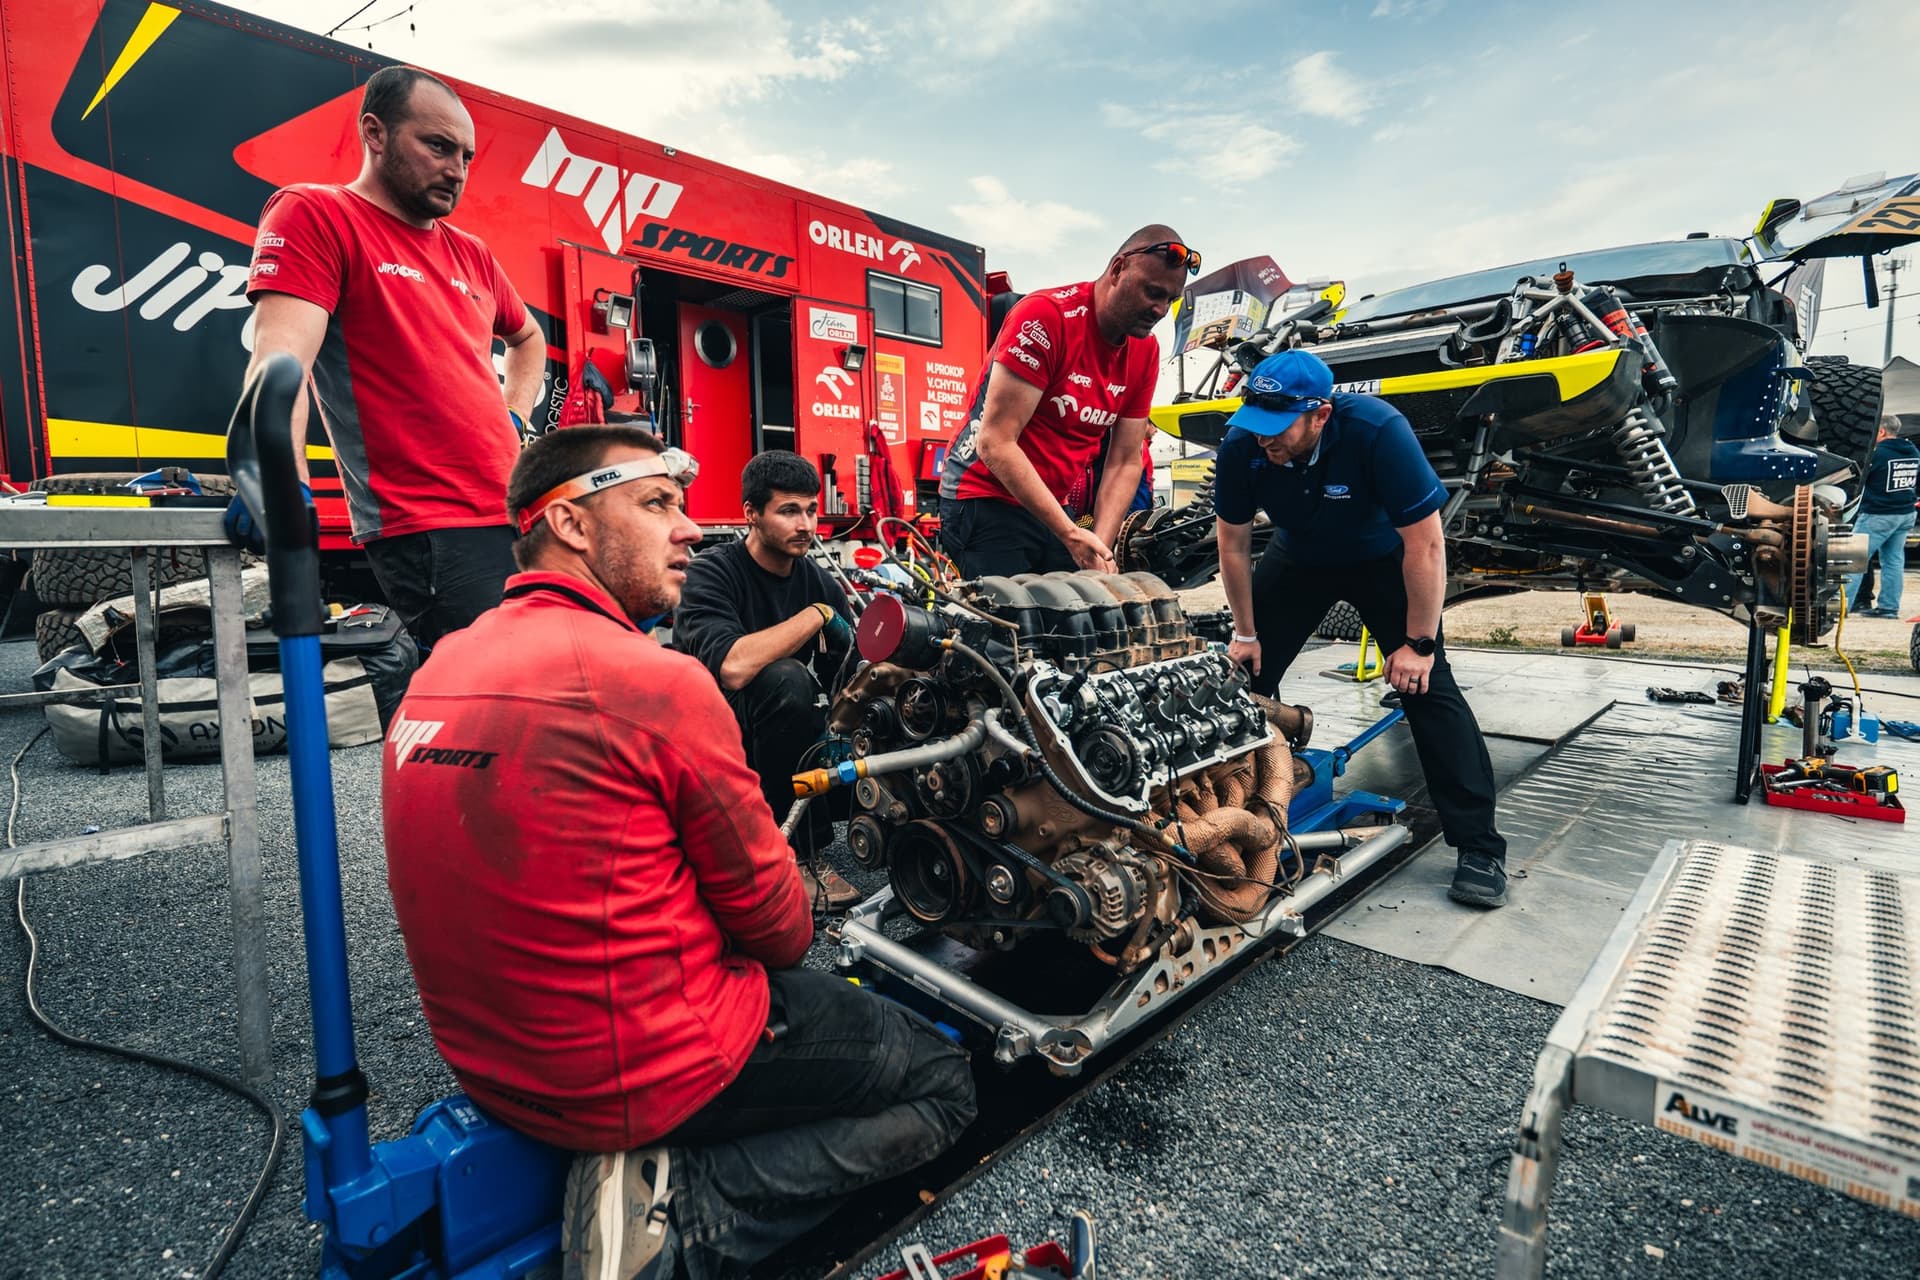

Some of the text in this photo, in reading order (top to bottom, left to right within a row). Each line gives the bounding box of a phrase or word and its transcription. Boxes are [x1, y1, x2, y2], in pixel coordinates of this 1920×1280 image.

[808, 220, 884, 261] ORLEN
[632, 222, 795, 278] SPORTS
[926, 362, 965, 378] M.PROKOP
[927, 377, 967, 394] V.CHYTKA
[1255, 377, 1277, 391] Ford
[1349, 381, 1376, 393] AZT
[927, 390, 964, 406] M.ERNST
[812, 403, 860, 420] ORLEN
[591, 472, 621, 488] PETZL
[408, 748, 499, 769] SPORTS
[1664, 1092, 1738, 1136] ALVE
